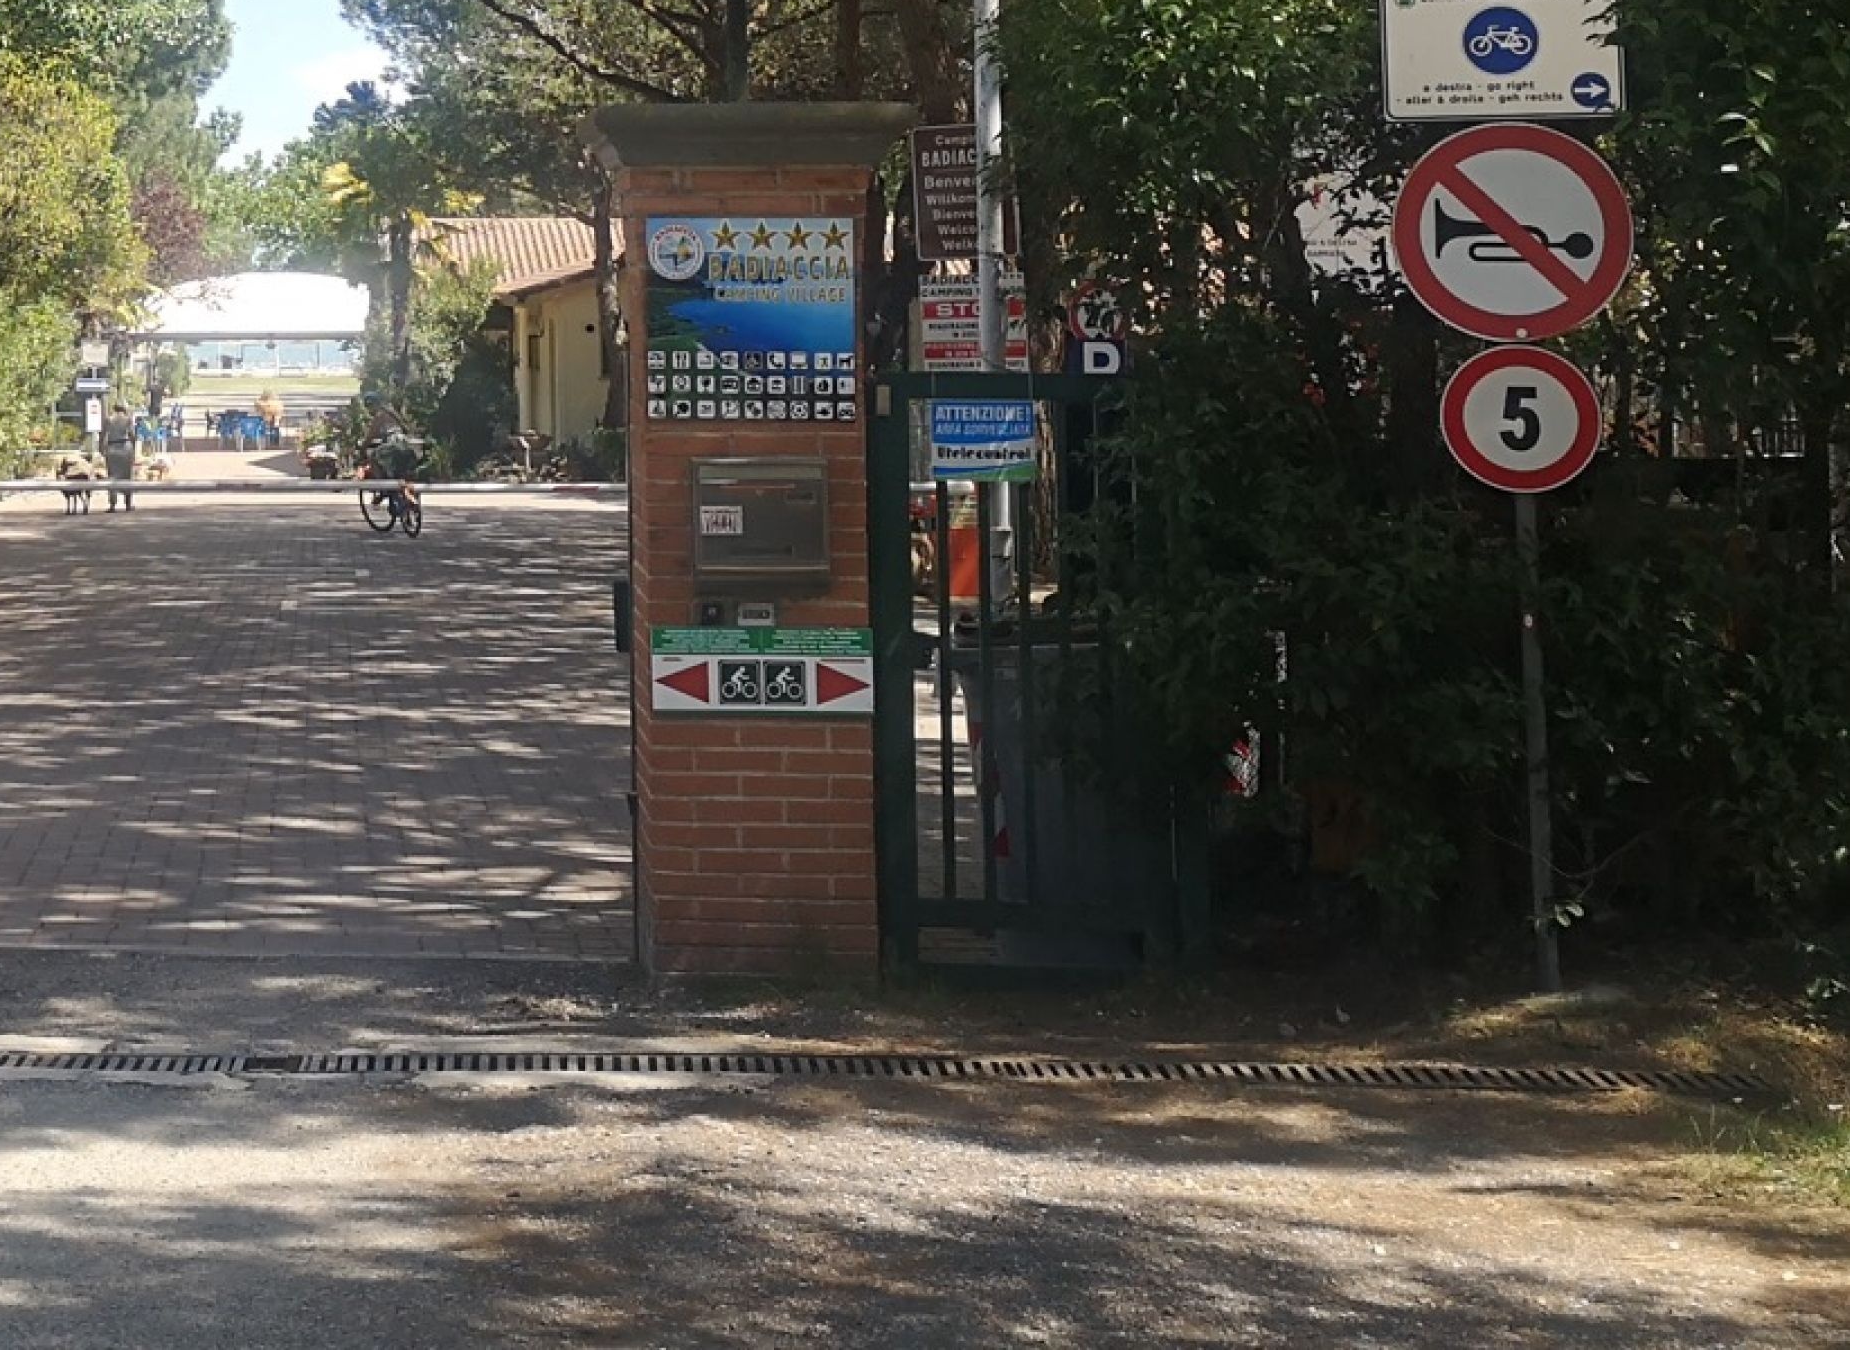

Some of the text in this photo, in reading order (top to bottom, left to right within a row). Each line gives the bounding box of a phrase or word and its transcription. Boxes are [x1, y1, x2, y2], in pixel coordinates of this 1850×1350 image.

[1435, 83, 1472, 92] destra
[1486, 83, 1501, 93] go
[1506, 80, 1536, 92] right
[1497, 93, 1520, 105] geh
[1524, 91, 1564, 102] rechts
[921, 148, 977, 168] BADIAC
[708, 254, 850, 280] BADIACCIA
[714, 286, 846, 302] CAMPING VILLAGE
[1083, 341, 1121, 375] D
[1499, 386, 1542, 452] 5
